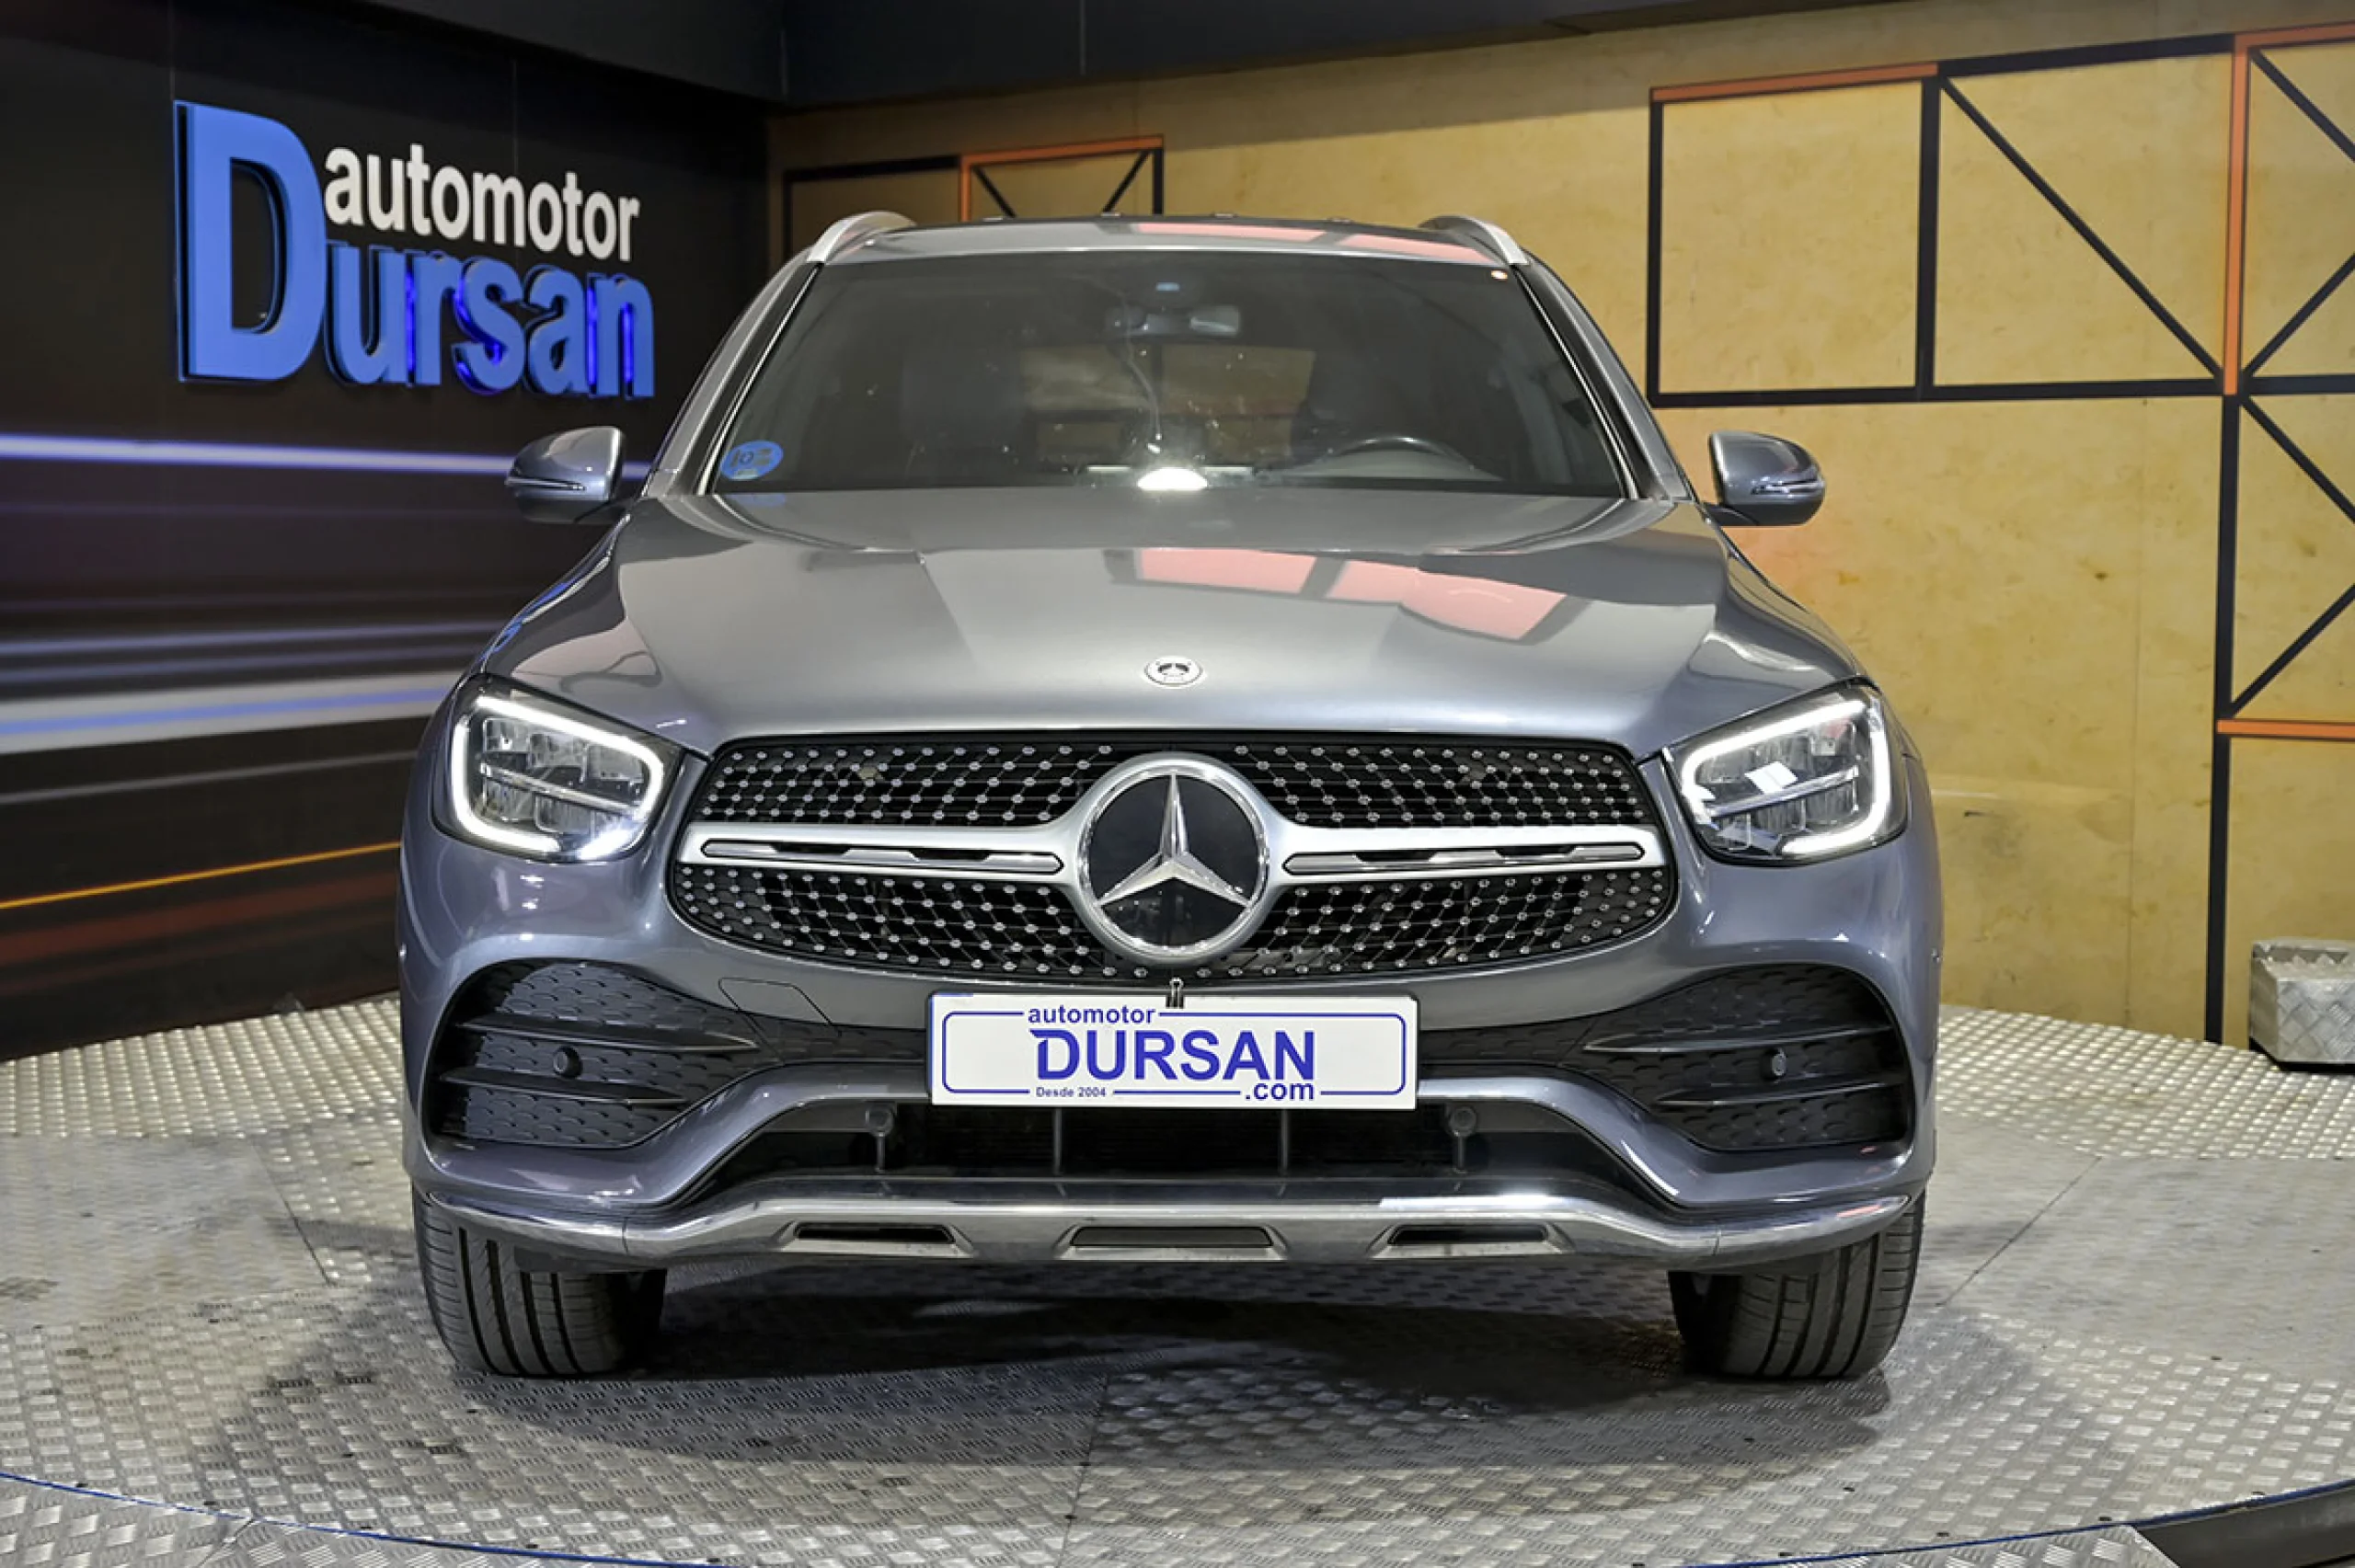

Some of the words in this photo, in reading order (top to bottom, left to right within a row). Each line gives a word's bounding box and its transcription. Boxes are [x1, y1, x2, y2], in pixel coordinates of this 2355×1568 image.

[325, 143, 640, 262] automotor
[174, 99, 655, 399] Dursan
[1028, 1004, 1156, 1024] automotor
[1028, 1029, 1315, 1081] DURSAN
[1035, 1086, 1074, 1098] Desde
[1077, 1086, 1107, 1098] 2004
[1245, 1081, 1315, 1102] .com
